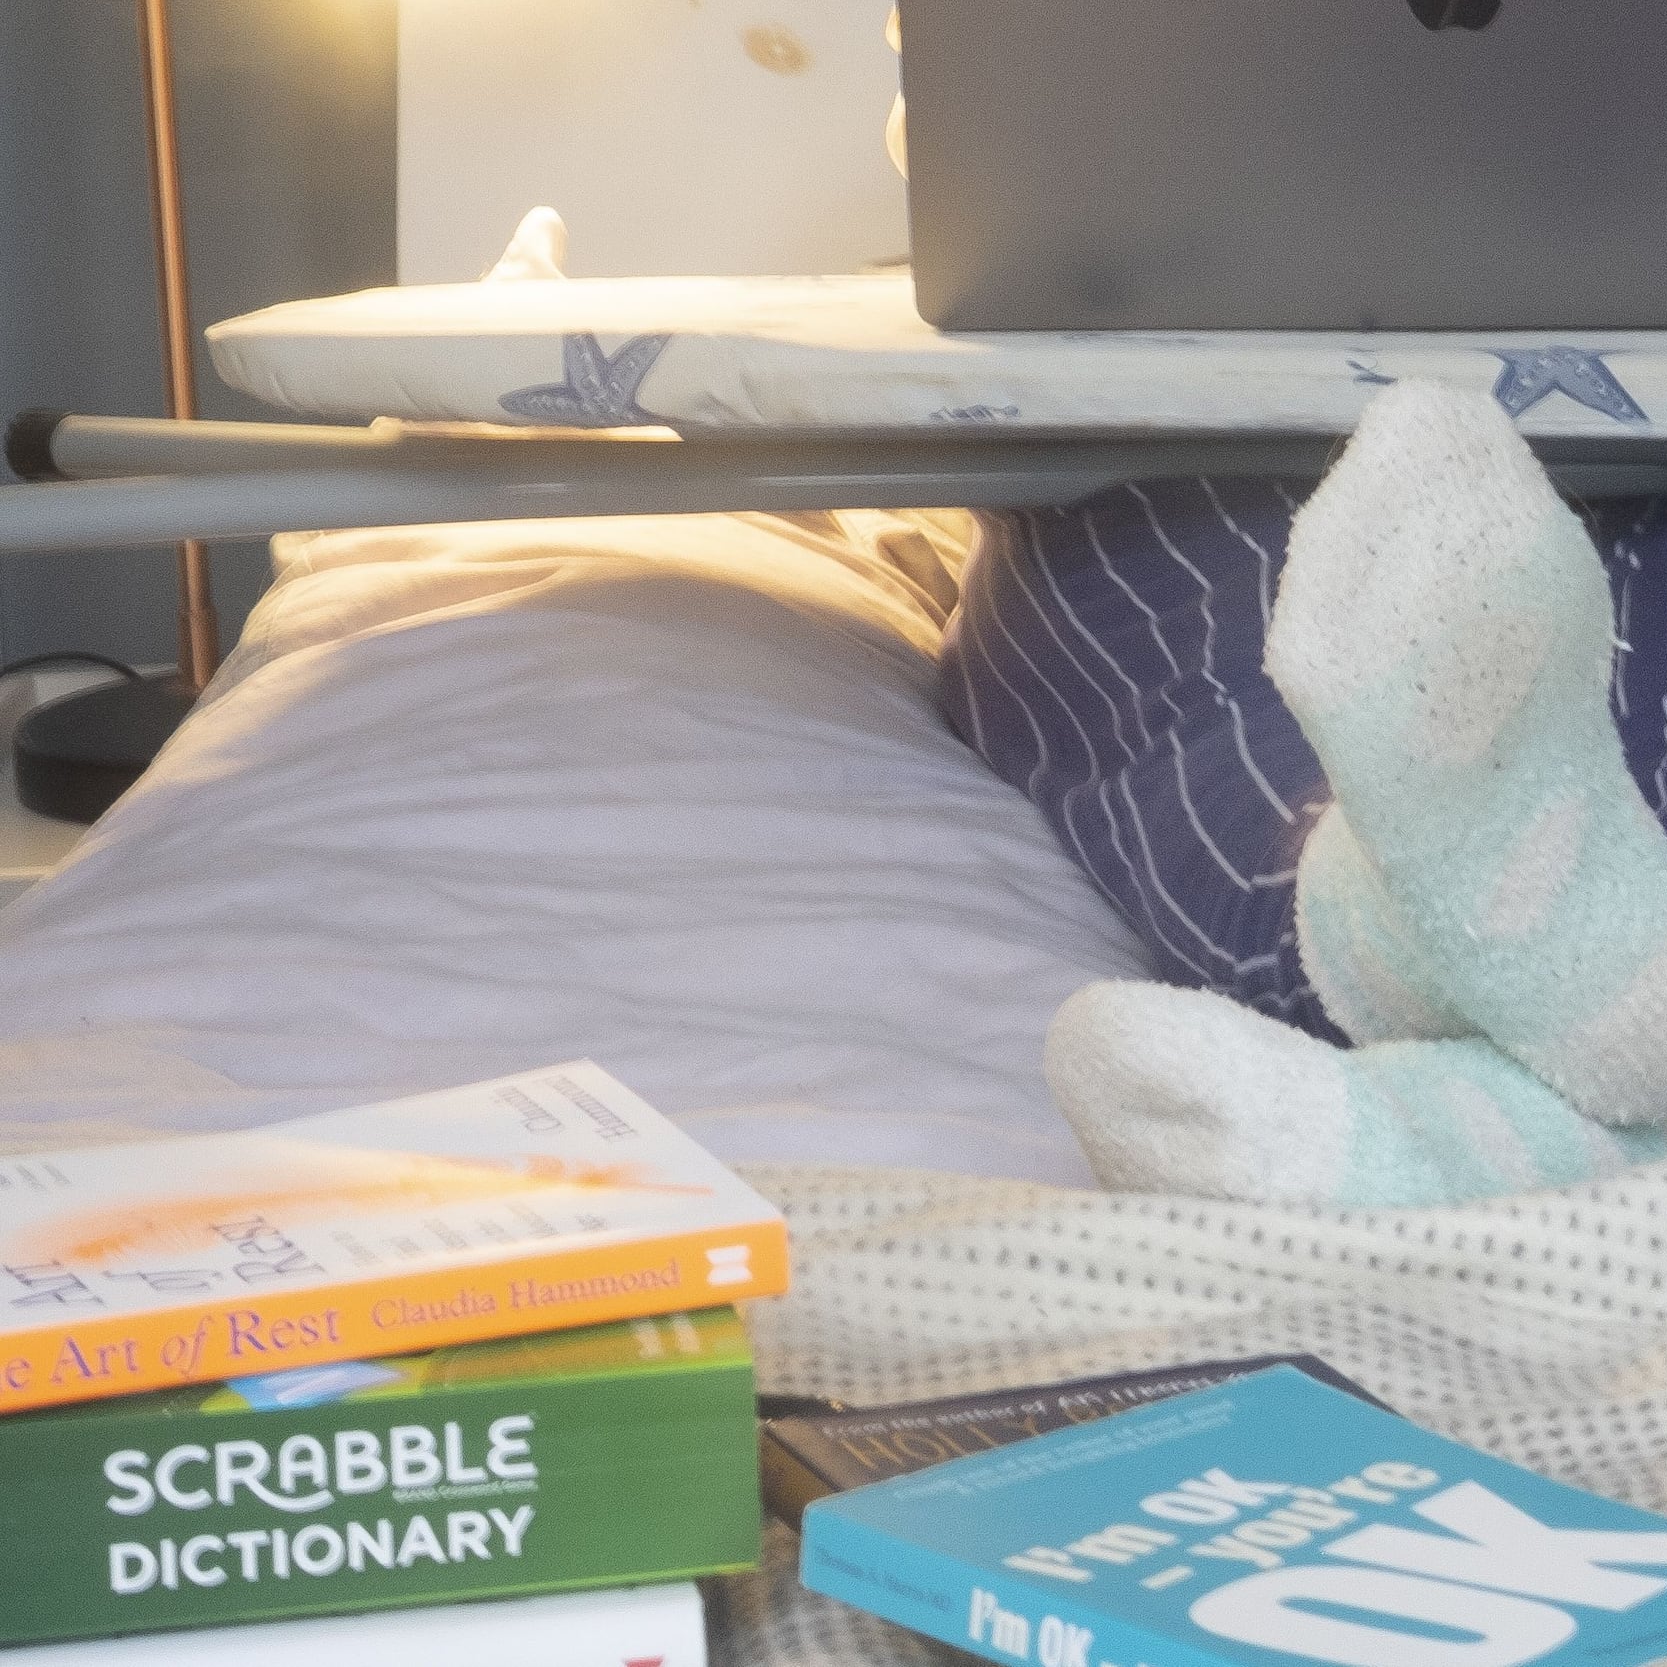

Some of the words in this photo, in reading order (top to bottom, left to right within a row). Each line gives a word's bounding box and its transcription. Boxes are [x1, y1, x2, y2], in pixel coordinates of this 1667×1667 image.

[50, 1336, 140, 1387] Art
[160, 1315, 214, 1377] of
[228, 1308, 341, 1359] Rest
[371, 1287, 497, 1330] Claudia
[508, 1258, 682, 1310] Hammond
[104, 1414, 538, 1516] SCRABBLE
[1140, 1466, 1296, 1528] OK
[108, 1504, 537, 1595] DICTIONARY
[969, 1586, 1030, 1661] I'm
[1037, 1614, 1096, 1667] OK
